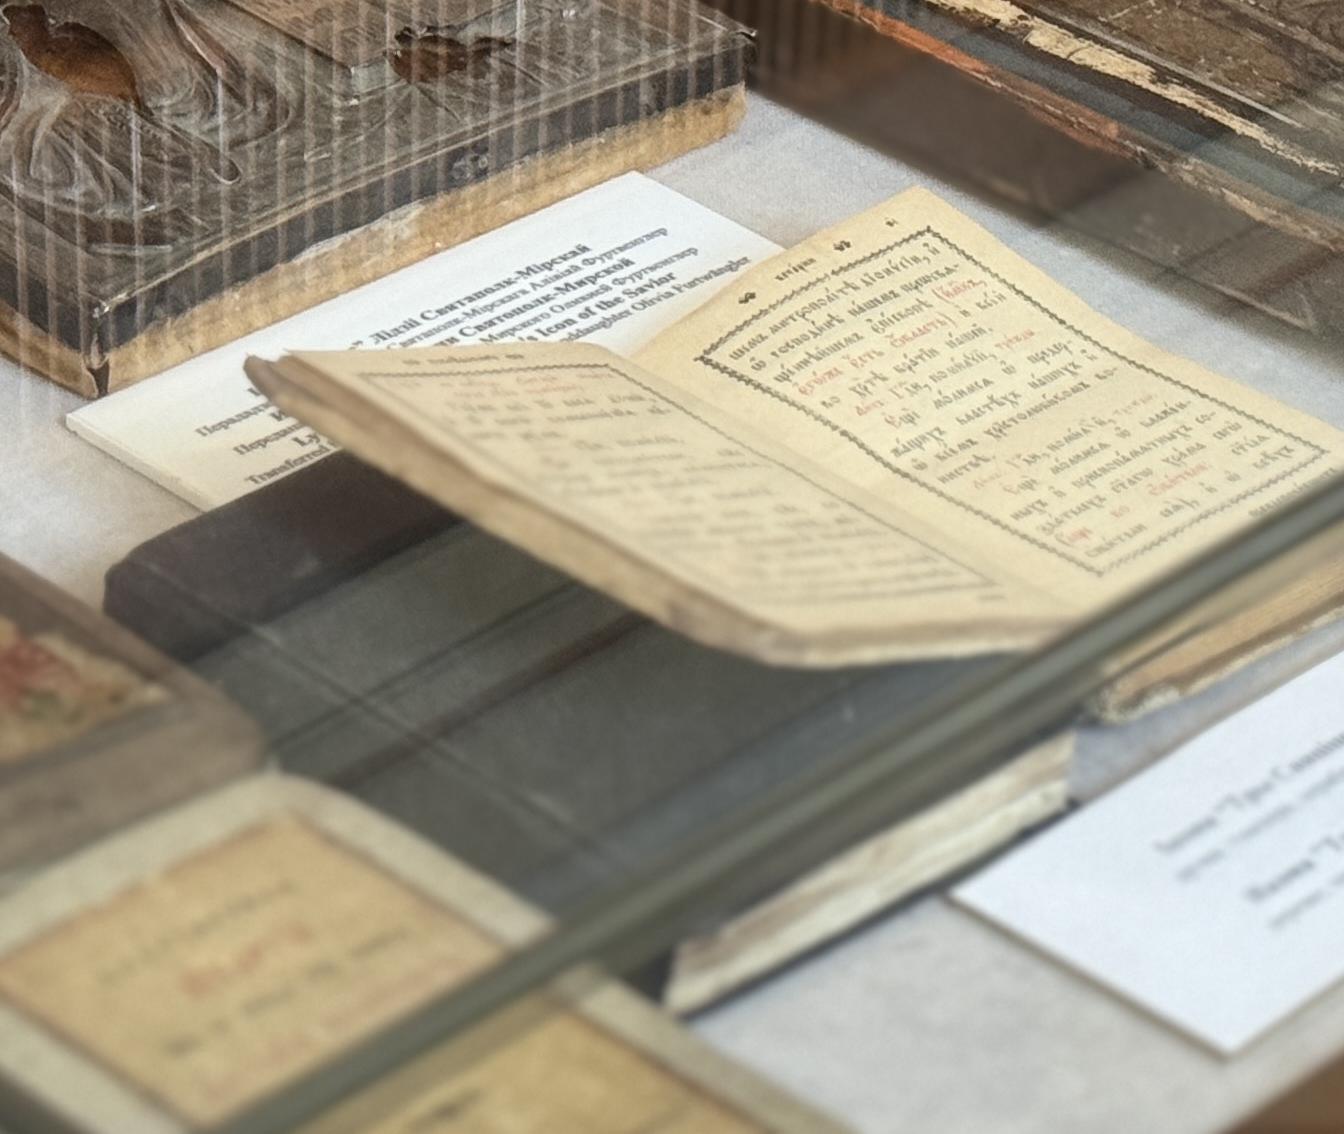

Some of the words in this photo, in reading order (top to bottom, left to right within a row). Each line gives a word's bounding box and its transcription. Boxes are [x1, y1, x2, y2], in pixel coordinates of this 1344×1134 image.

[534, 317, 578, 337] Icon
[577, 306, 597, 320] of
[594, 296, 625, 311] the
[621, 272, 676, 299] Savior
